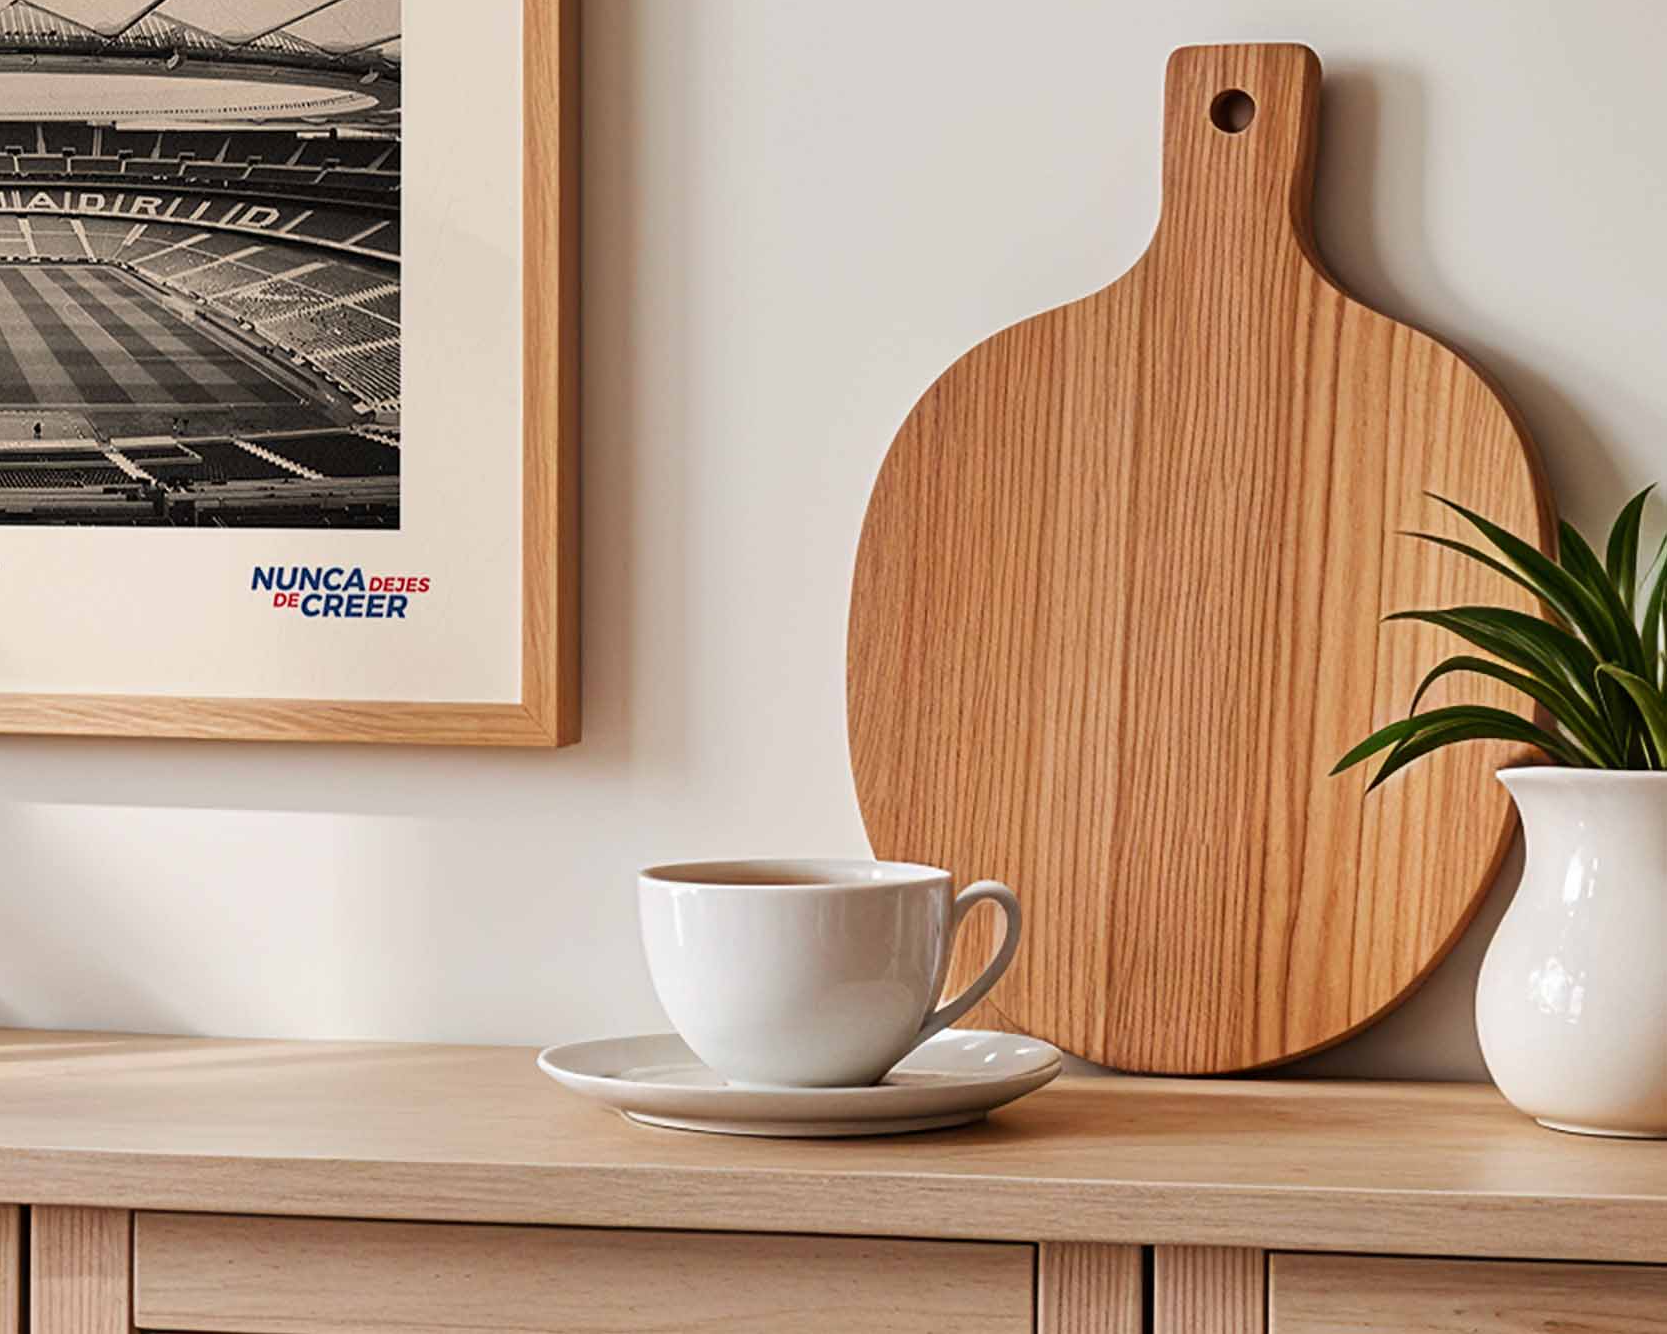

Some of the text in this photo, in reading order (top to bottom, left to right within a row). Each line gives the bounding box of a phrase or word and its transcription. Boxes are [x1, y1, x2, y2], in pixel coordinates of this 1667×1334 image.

[251, 566, 431, 593] NUNCA DEJES
[273, 592, 409, 618] DE CREER
